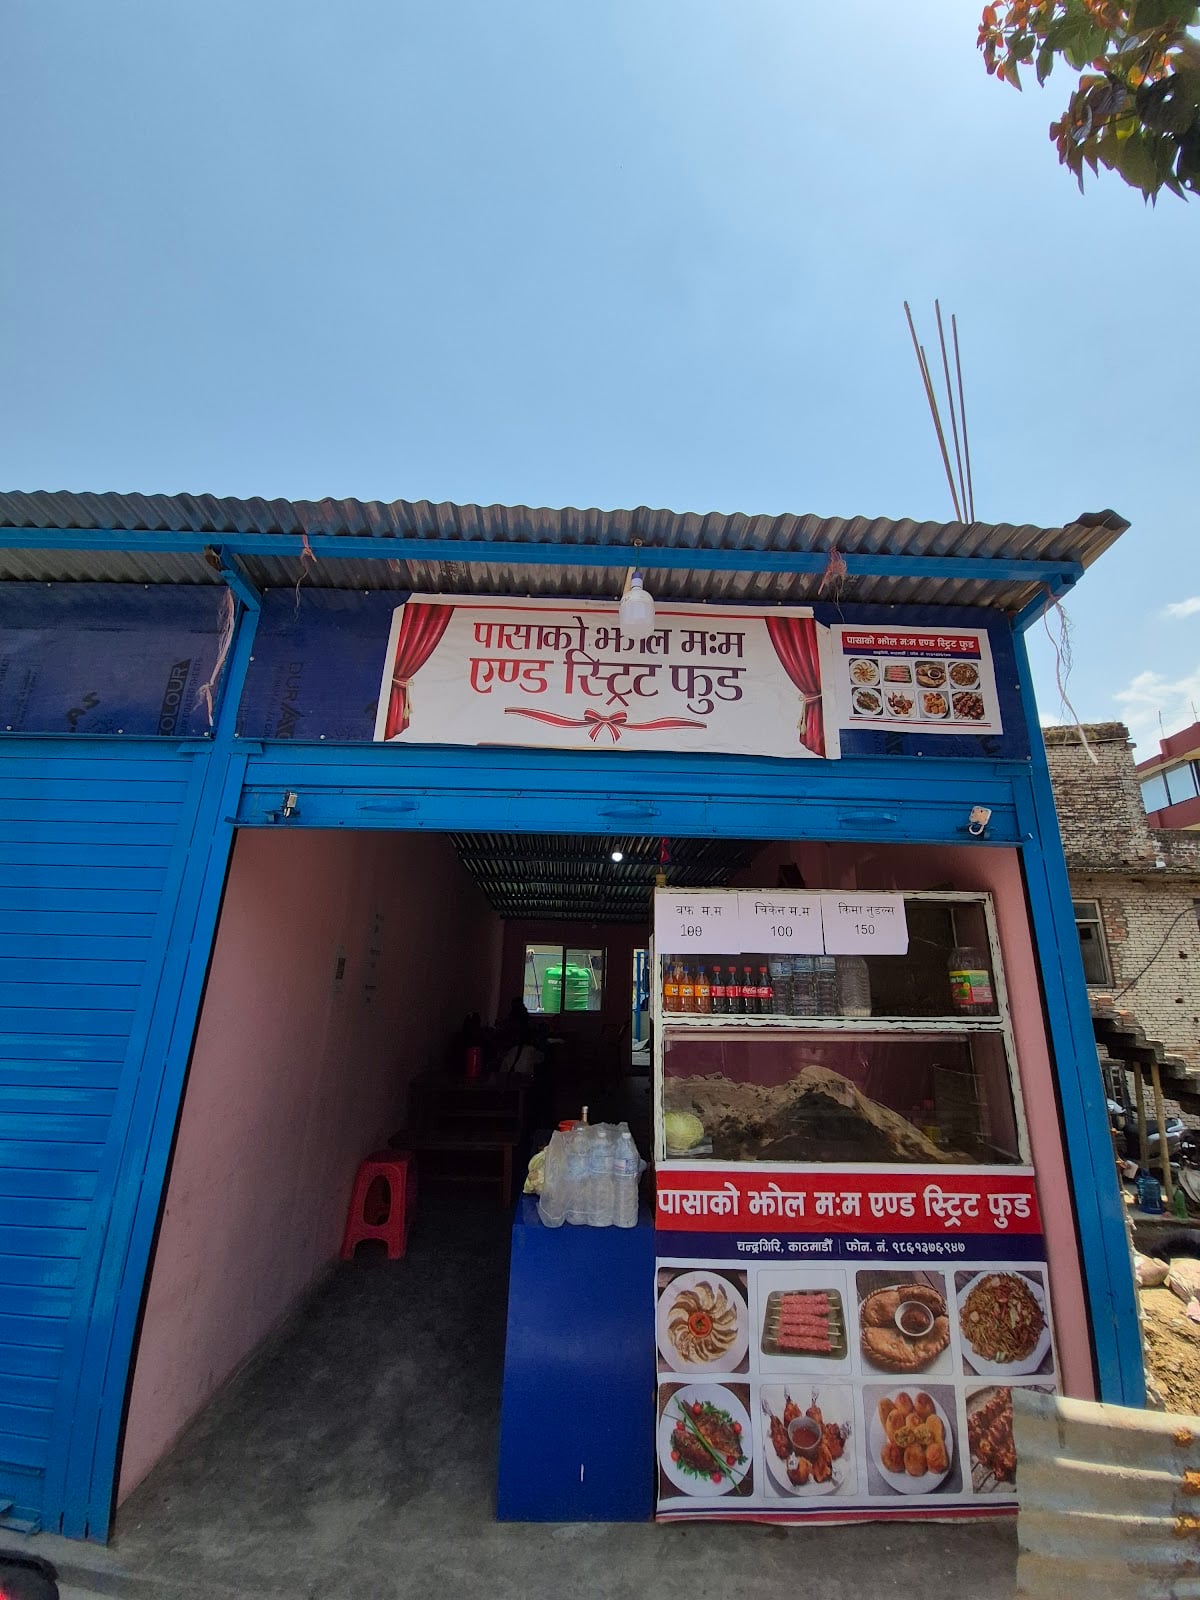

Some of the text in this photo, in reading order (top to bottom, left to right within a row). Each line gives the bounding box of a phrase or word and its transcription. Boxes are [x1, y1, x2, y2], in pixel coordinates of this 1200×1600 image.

[473, 616, 588, 651] पासाको
[469, 657, 555, 694] एण्ड
[669, 664, 747, 714] फुड
[680, 924, 703, 937] 100
[770, 925, 793, 938] 100
[855, 924, 875, 935] 150
[656, 1181, 741, 1216] पासाको
[747, 1182, 807, 1218] झोल
[867, 1193, 917, 1218] एण्ड
[986, 1193, 1032, 1229] फुड
